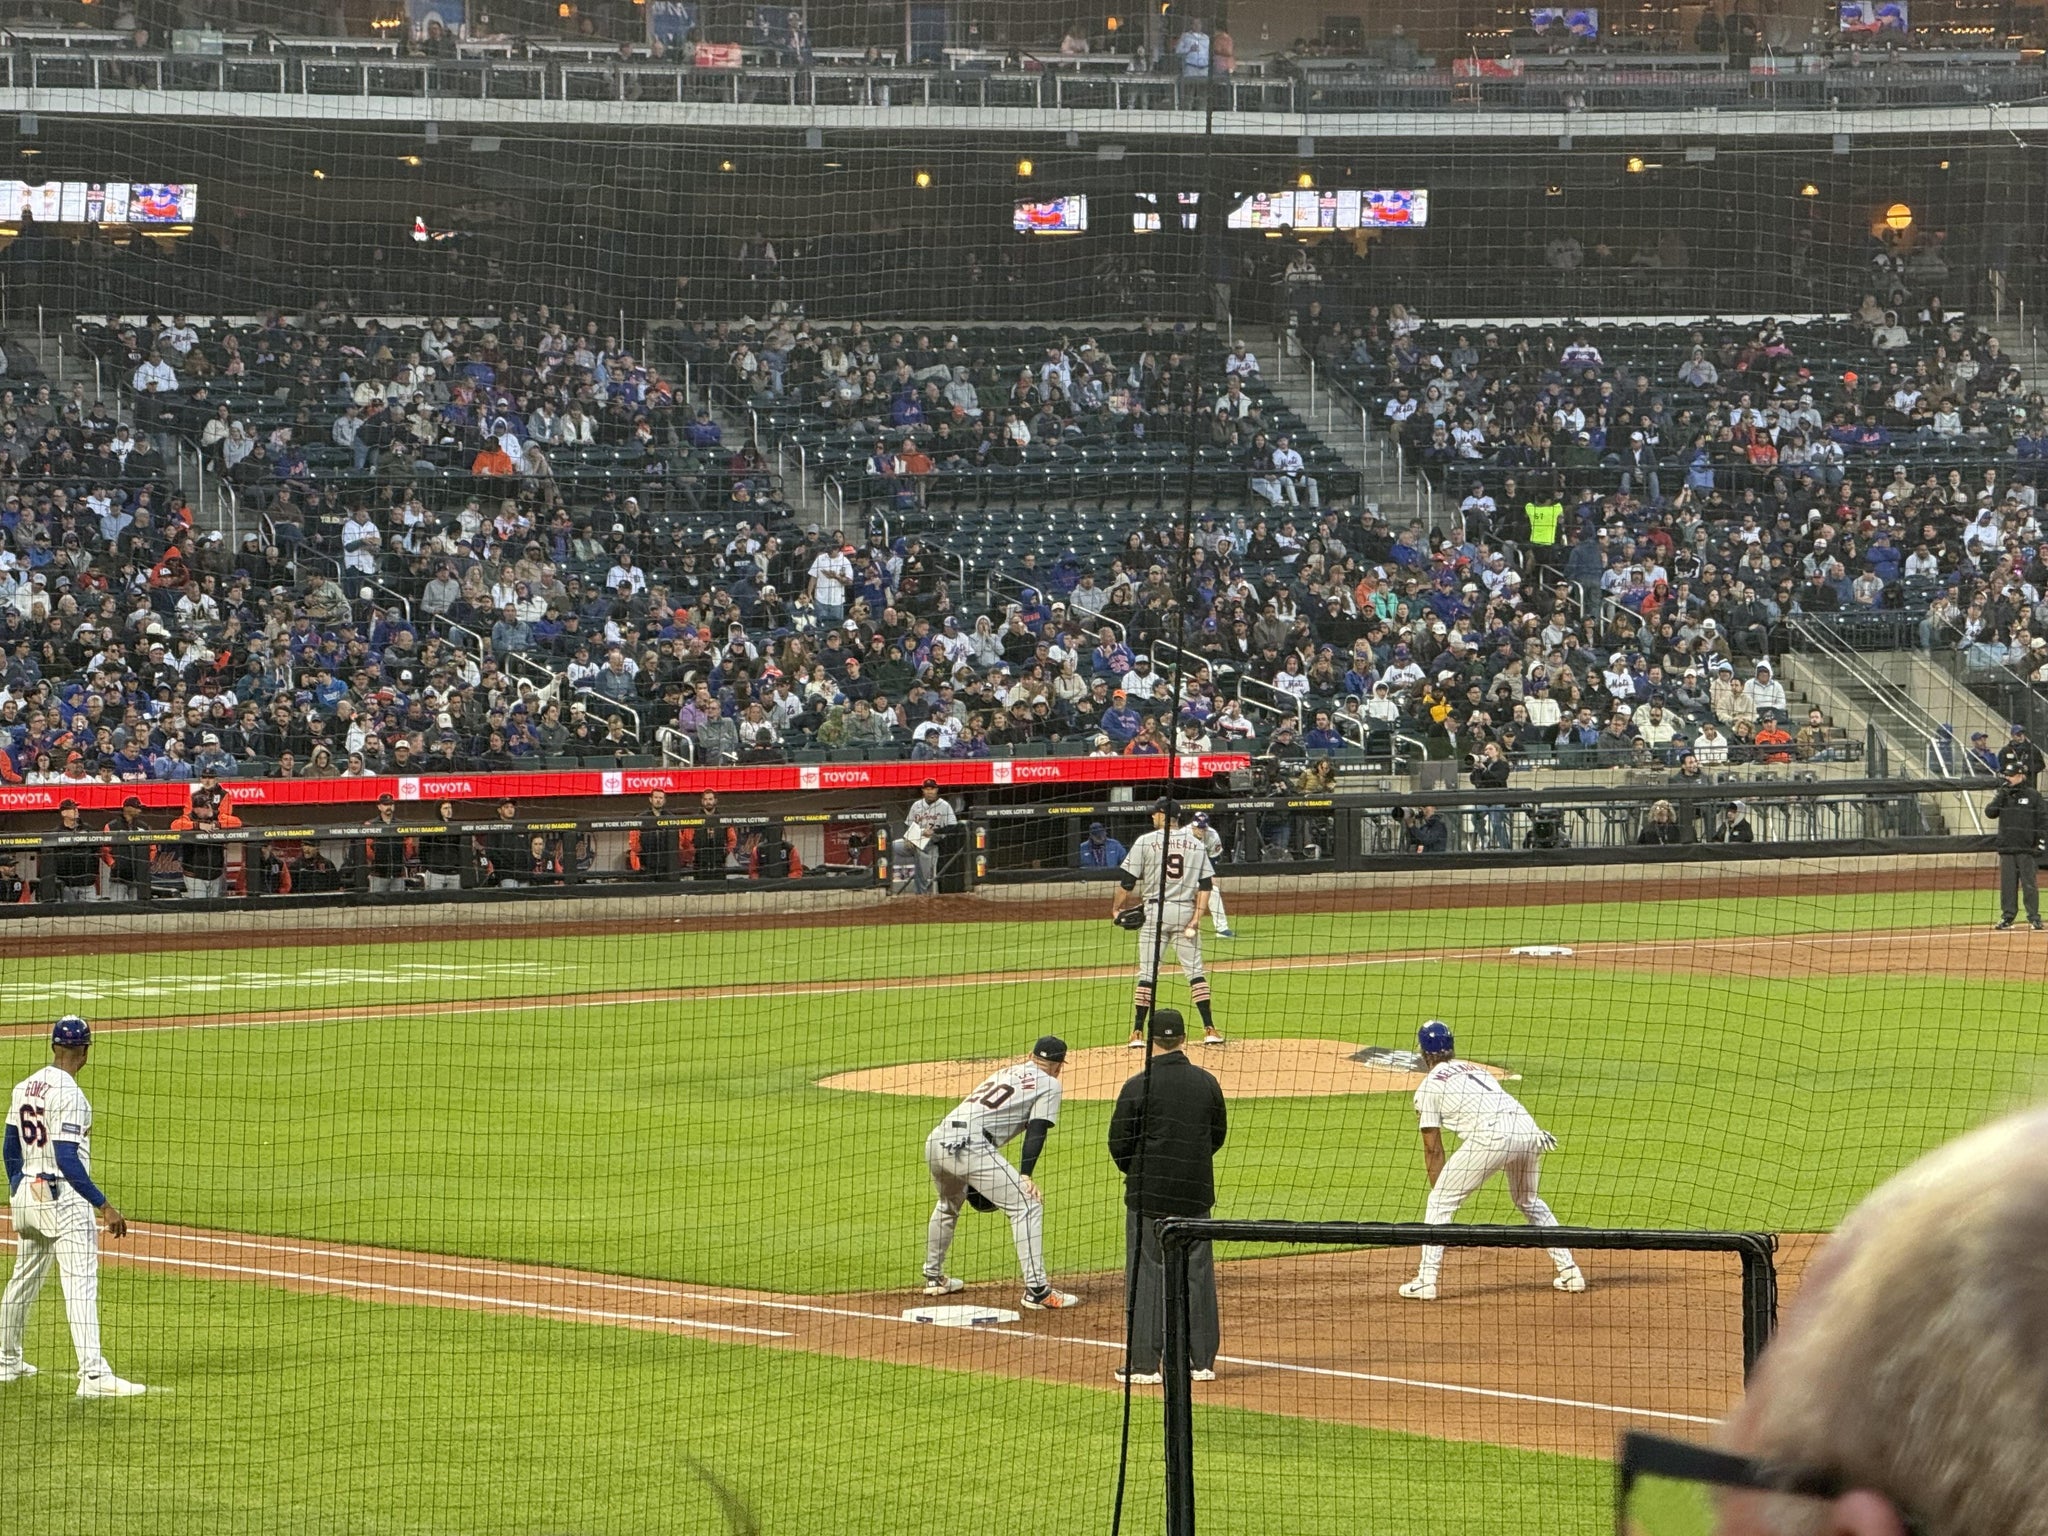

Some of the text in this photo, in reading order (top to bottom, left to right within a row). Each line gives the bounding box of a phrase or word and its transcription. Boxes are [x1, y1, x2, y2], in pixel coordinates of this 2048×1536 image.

[823, 772, 870, 782] TOYOTA
[1015, 766, 1060, 777] TOYOTA
[422, 782, 472, 794] TOYOTA
[626, 777, 674, 788] TOYOTA
[0, 793, 52, 804] TOYOTA
[1151, 838, 1198, 853] FLHERTY
[1166, 854, 1184, 880] 9
[1468, 1074, 1493, 1092] 1
[965, 1081, 1016, 1110] 20
